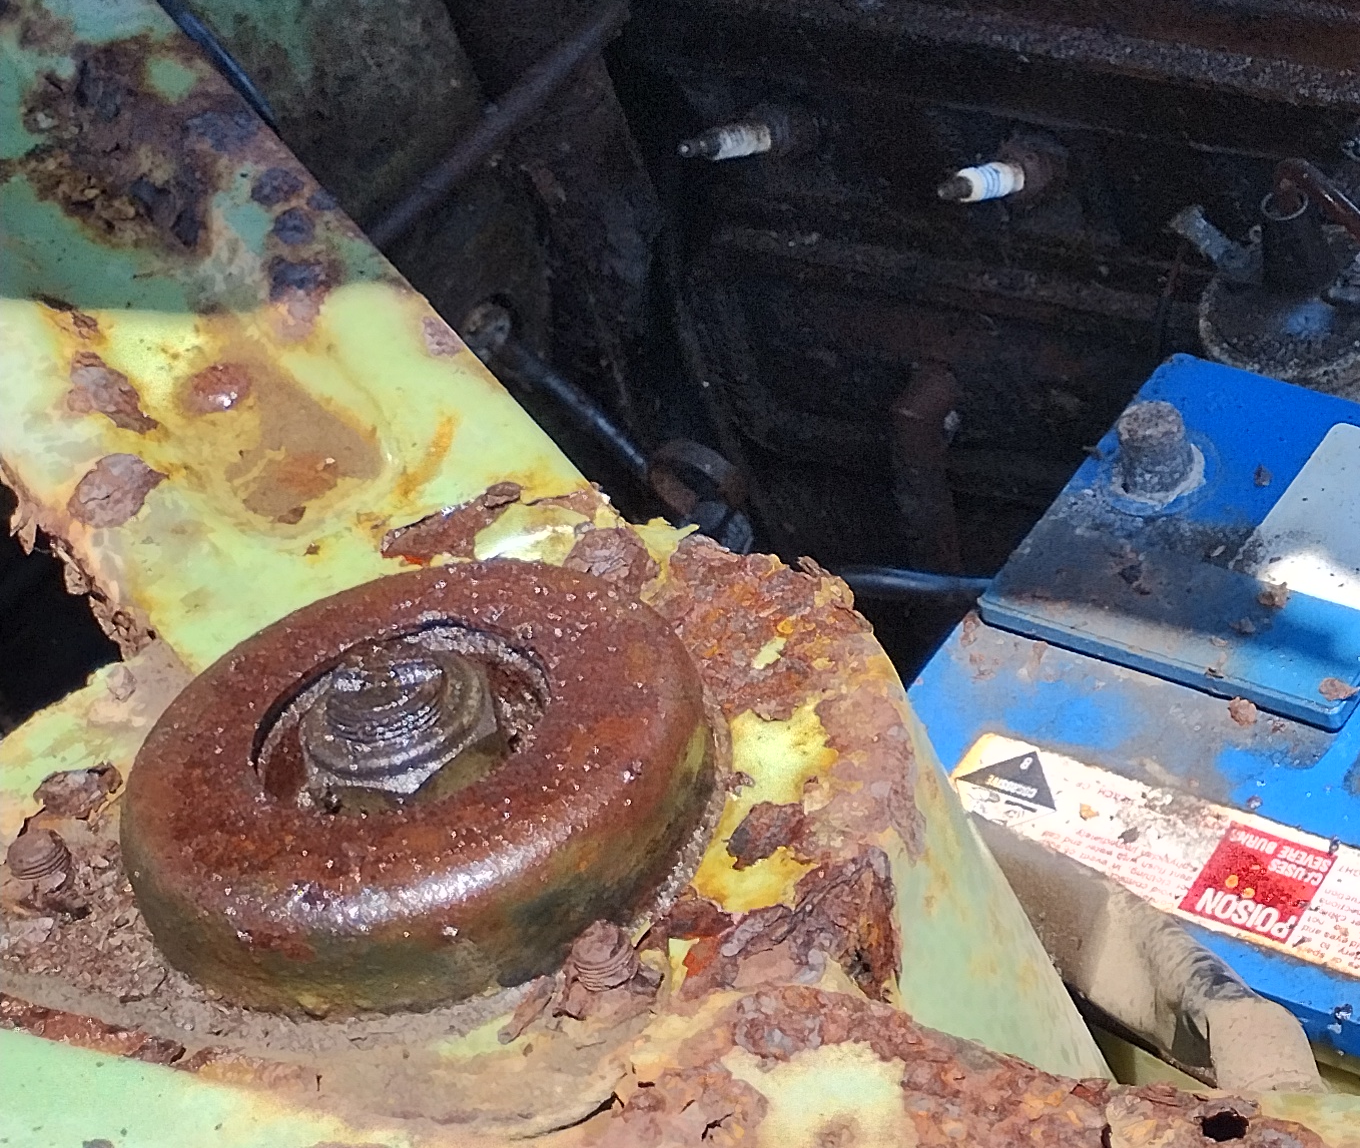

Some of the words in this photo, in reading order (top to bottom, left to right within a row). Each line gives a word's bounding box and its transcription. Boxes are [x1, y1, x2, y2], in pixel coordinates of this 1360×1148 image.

[1020, 757, 1033, 769] 8
[1226, 827, 1278, 855] BURNS
[1276, 844, 1333, 872] SEVERE
[1266, 857, 1324, 886] CAUSES
[1193, 885, 1299, 939] POISON
[1306, 914, 1325, 926] not
[1301, 924, 1321, 936] and
[1318, 940, 1331, 950] to
